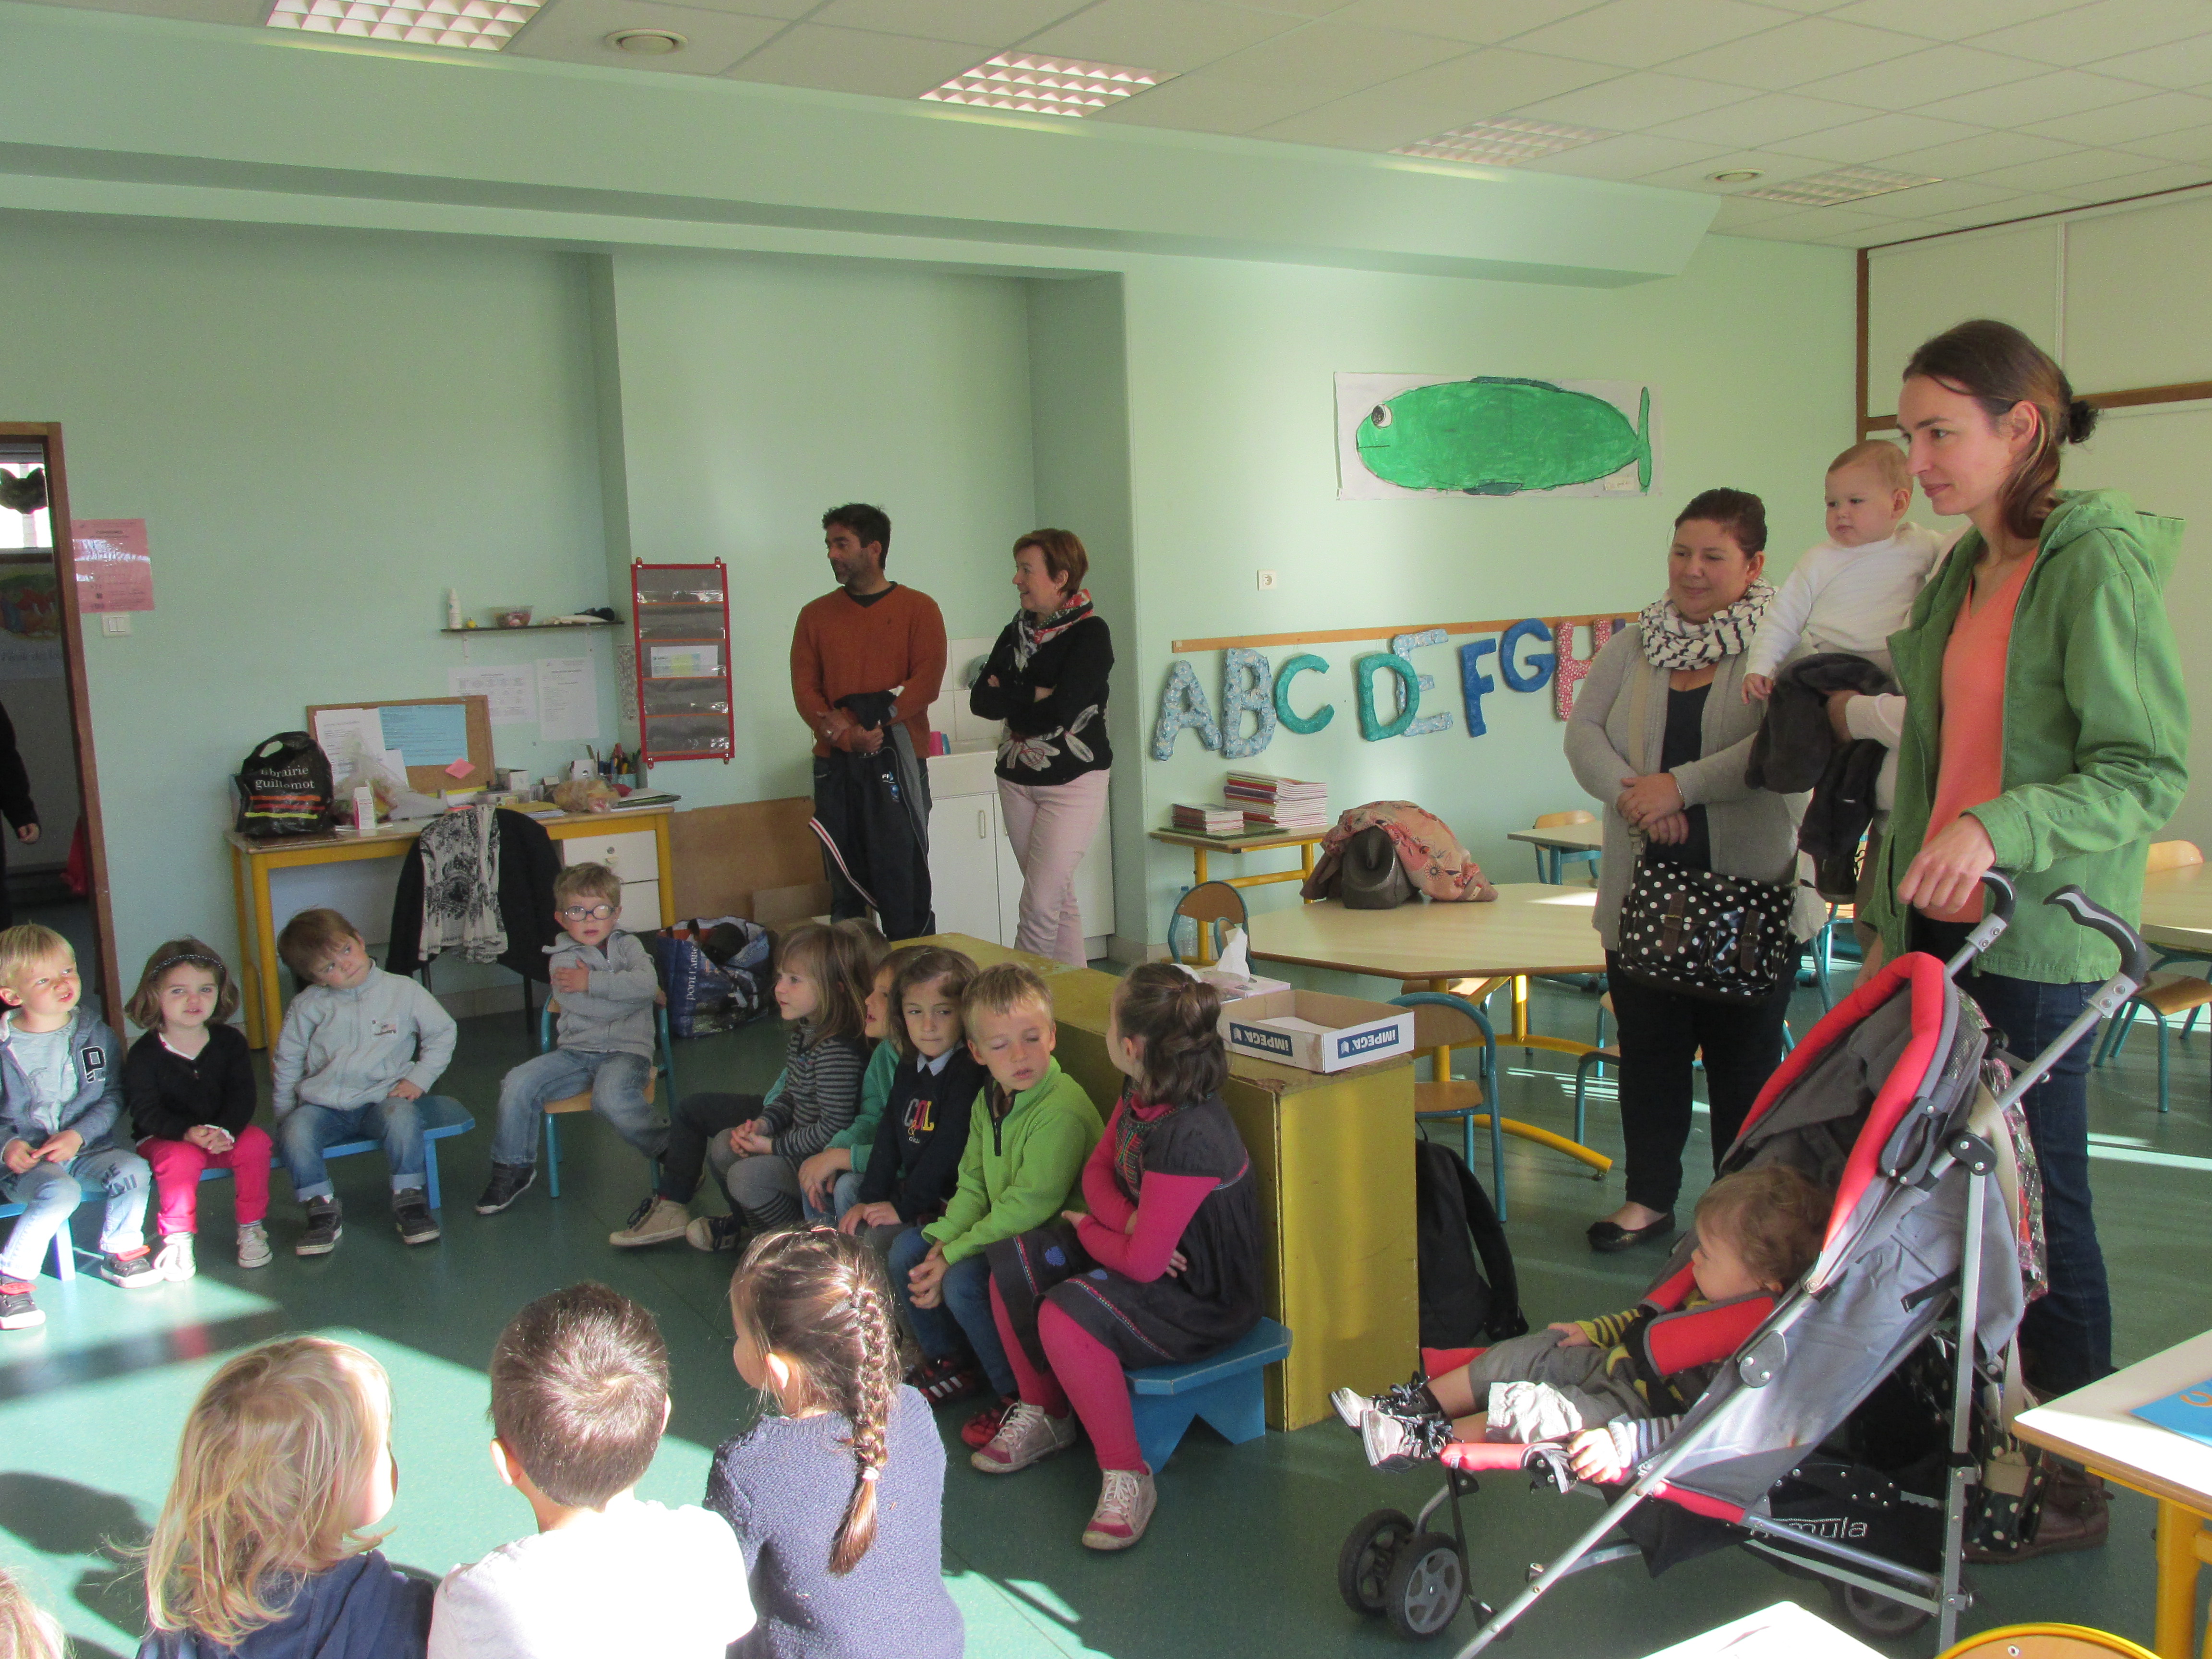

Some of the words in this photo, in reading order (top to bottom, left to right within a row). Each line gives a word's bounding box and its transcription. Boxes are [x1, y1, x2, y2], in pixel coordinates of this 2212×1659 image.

[1153, 661, 1223, 761] A
[1222, 648, 1277, 759] B
[1275, 653, 1334, 735] C
[1357, 653, 1420, 742] D
[1392, 628, 1454, 737] E
[1460, 638, 1496, 738] F
[1500, 618, 1555, 694] G
[904, 1098, 934, 1131] COL
